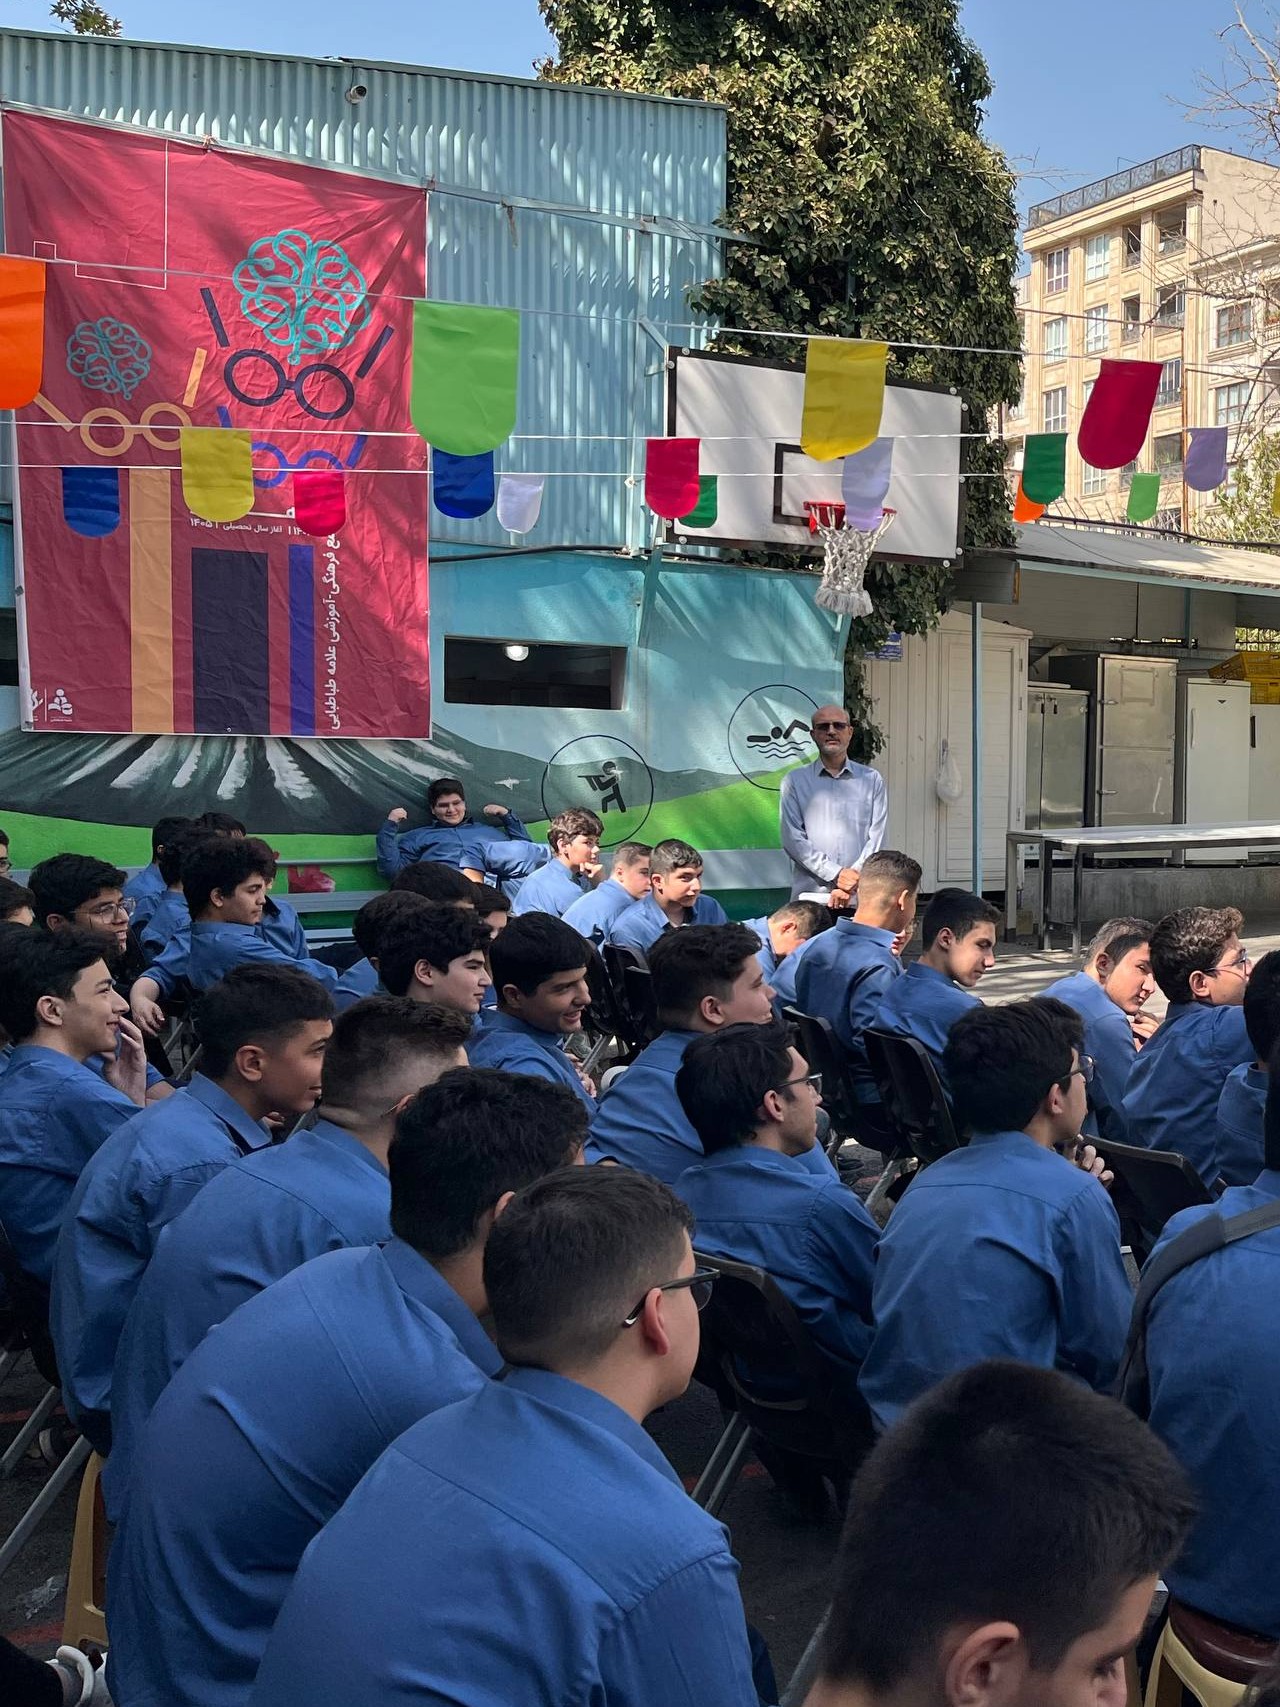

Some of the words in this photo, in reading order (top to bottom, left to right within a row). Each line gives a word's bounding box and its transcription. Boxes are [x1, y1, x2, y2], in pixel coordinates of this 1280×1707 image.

[222, 521, 252, 531] تحصیلی
[253, 524, 269, 534] سال
[325, 645, 337, 676] علامه
[324, 678, 340, 730] طباطبایی
